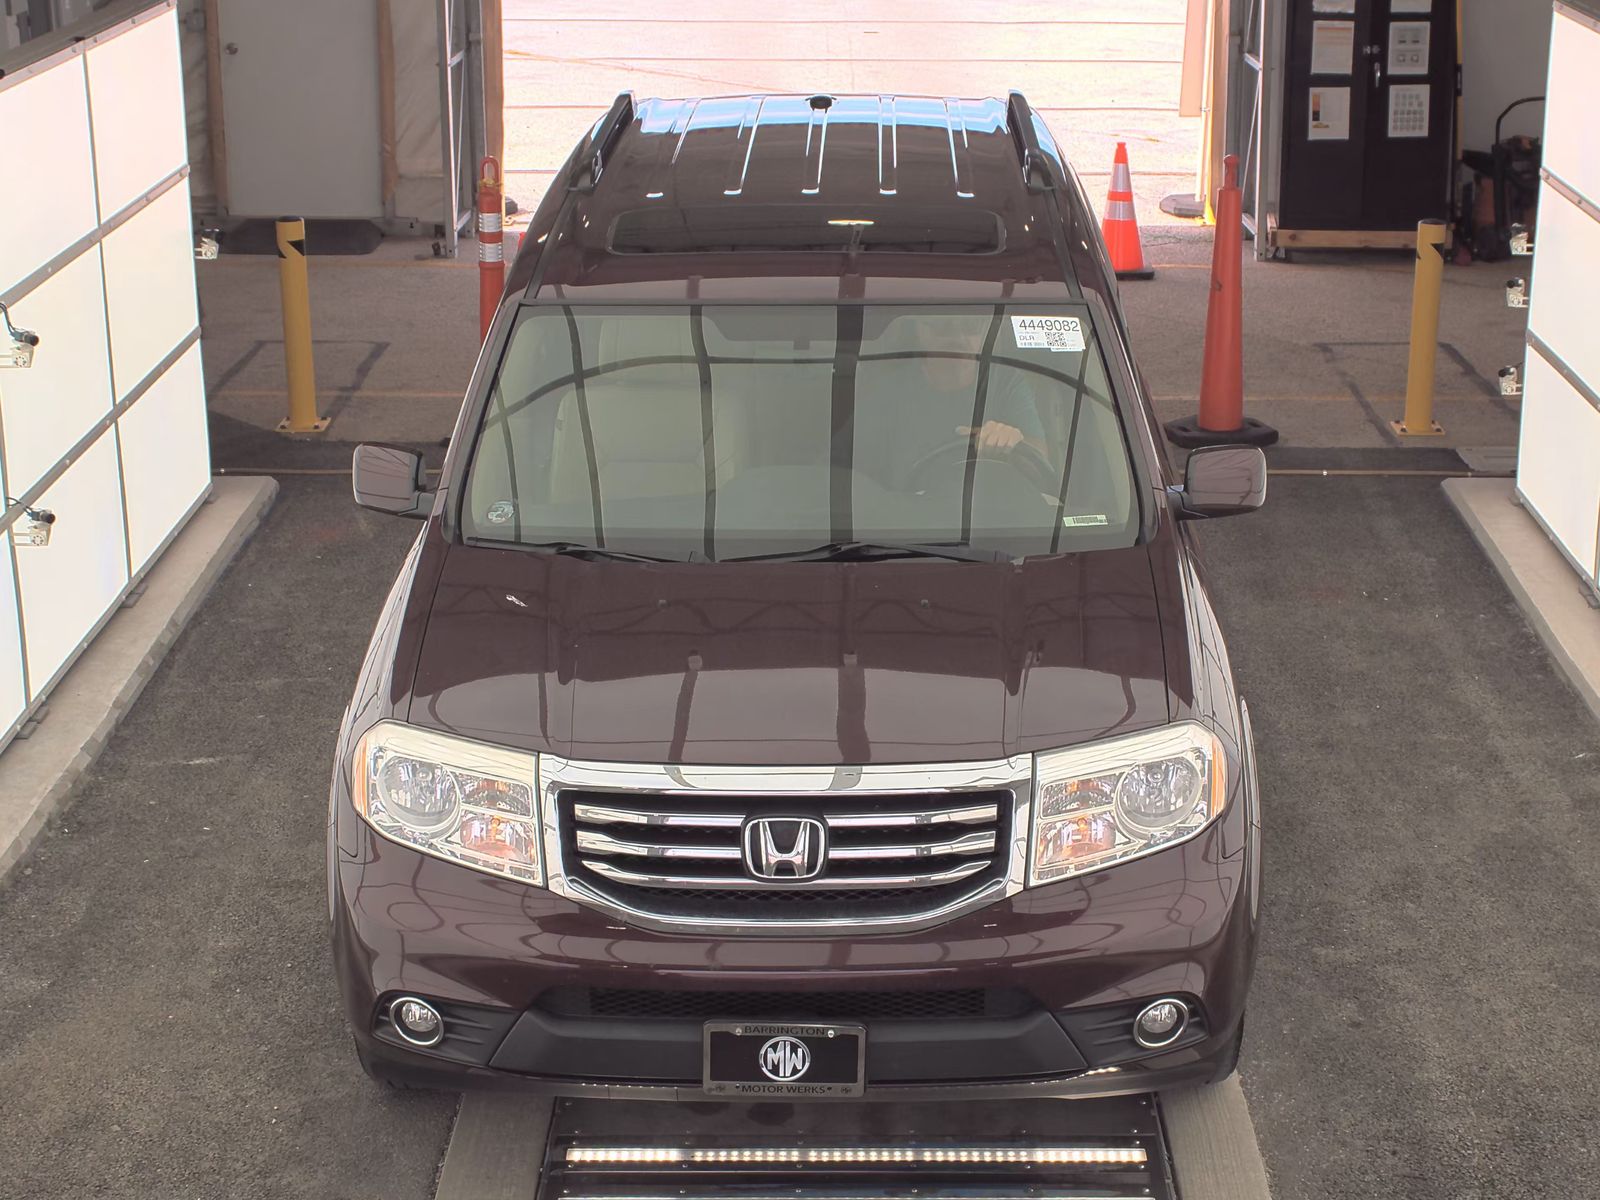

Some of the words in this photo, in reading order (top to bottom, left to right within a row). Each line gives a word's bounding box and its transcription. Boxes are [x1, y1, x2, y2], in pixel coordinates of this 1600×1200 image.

[1019, 319, 1080, 332] 4449082
[744, 1025, 825, 1036] BARRINGTON
[741, 1085, 784, 1094] MOTOR
[786, 1085, 826, 1094] WERKS
